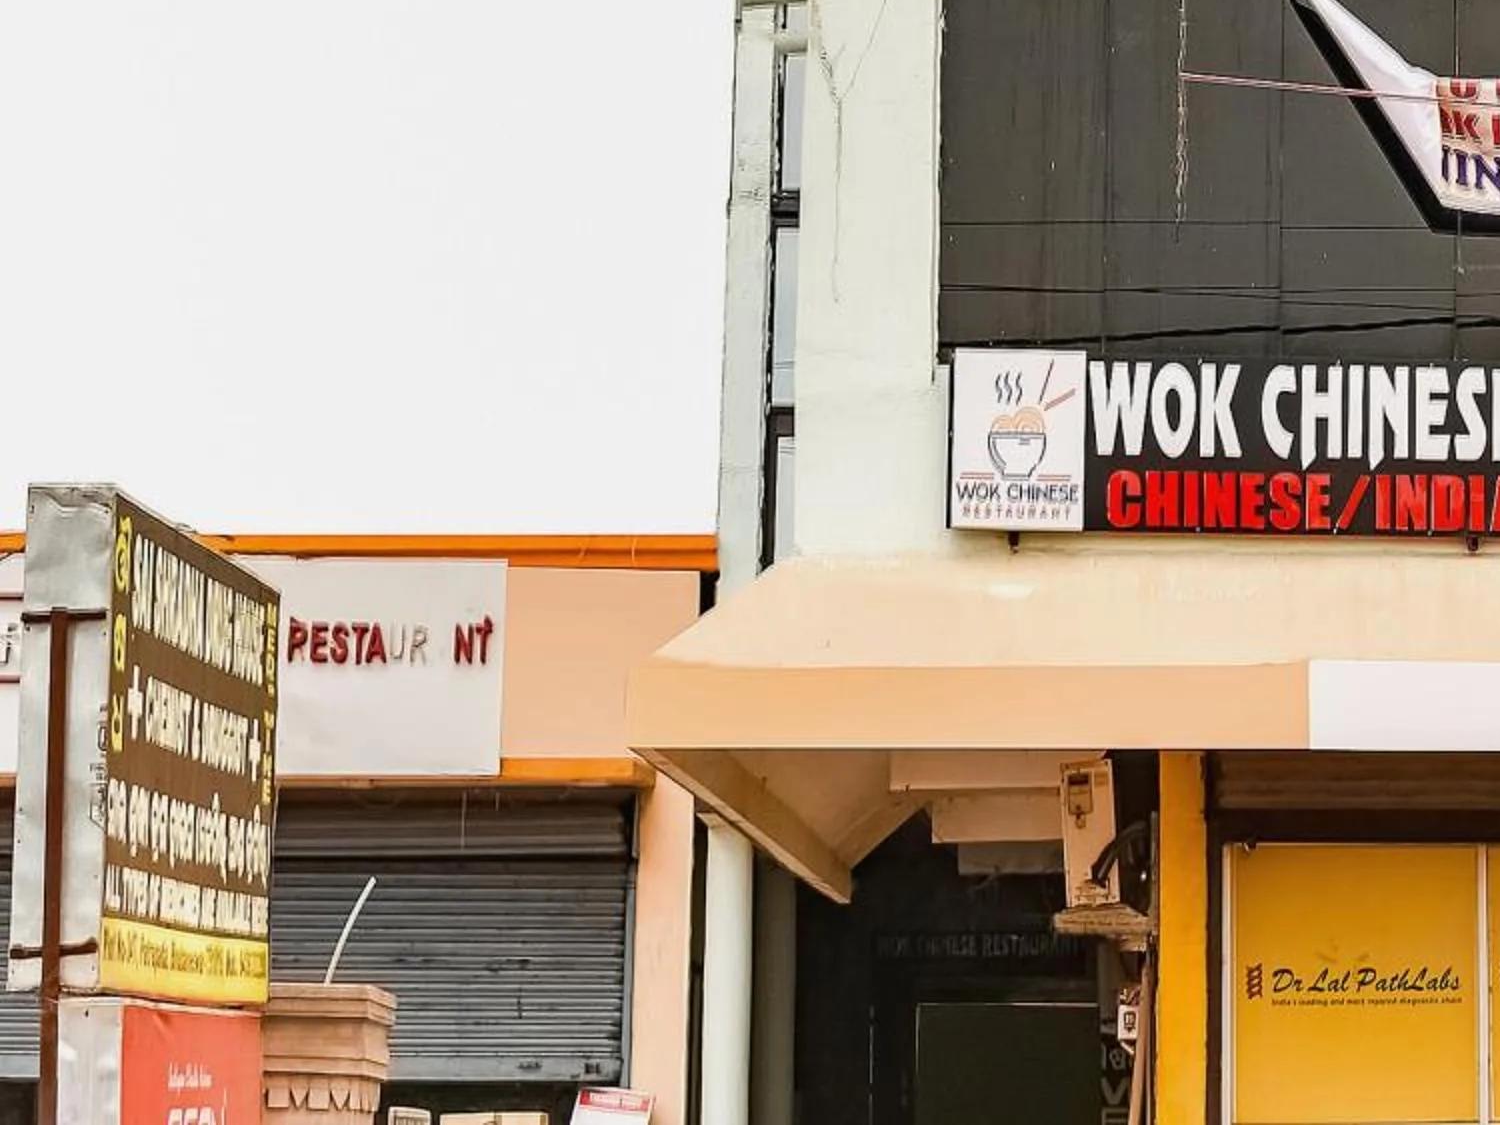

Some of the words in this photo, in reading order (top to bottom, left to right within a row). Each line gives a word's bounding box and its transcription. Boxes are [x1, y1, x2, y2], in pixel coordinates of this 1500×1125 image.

[1088, 359, 1243, 459] WOK
[956, 483, 1000, 502] WOK
[1007, 483, 1079, 504] CHINESE
[962, 504, 1072, 521] RESTAURANT
[1272, 968, 1302, 992] Dr
[1307, 967, 1350, 992] Lal
[1356, 966, 1461, 993] PathLabs
